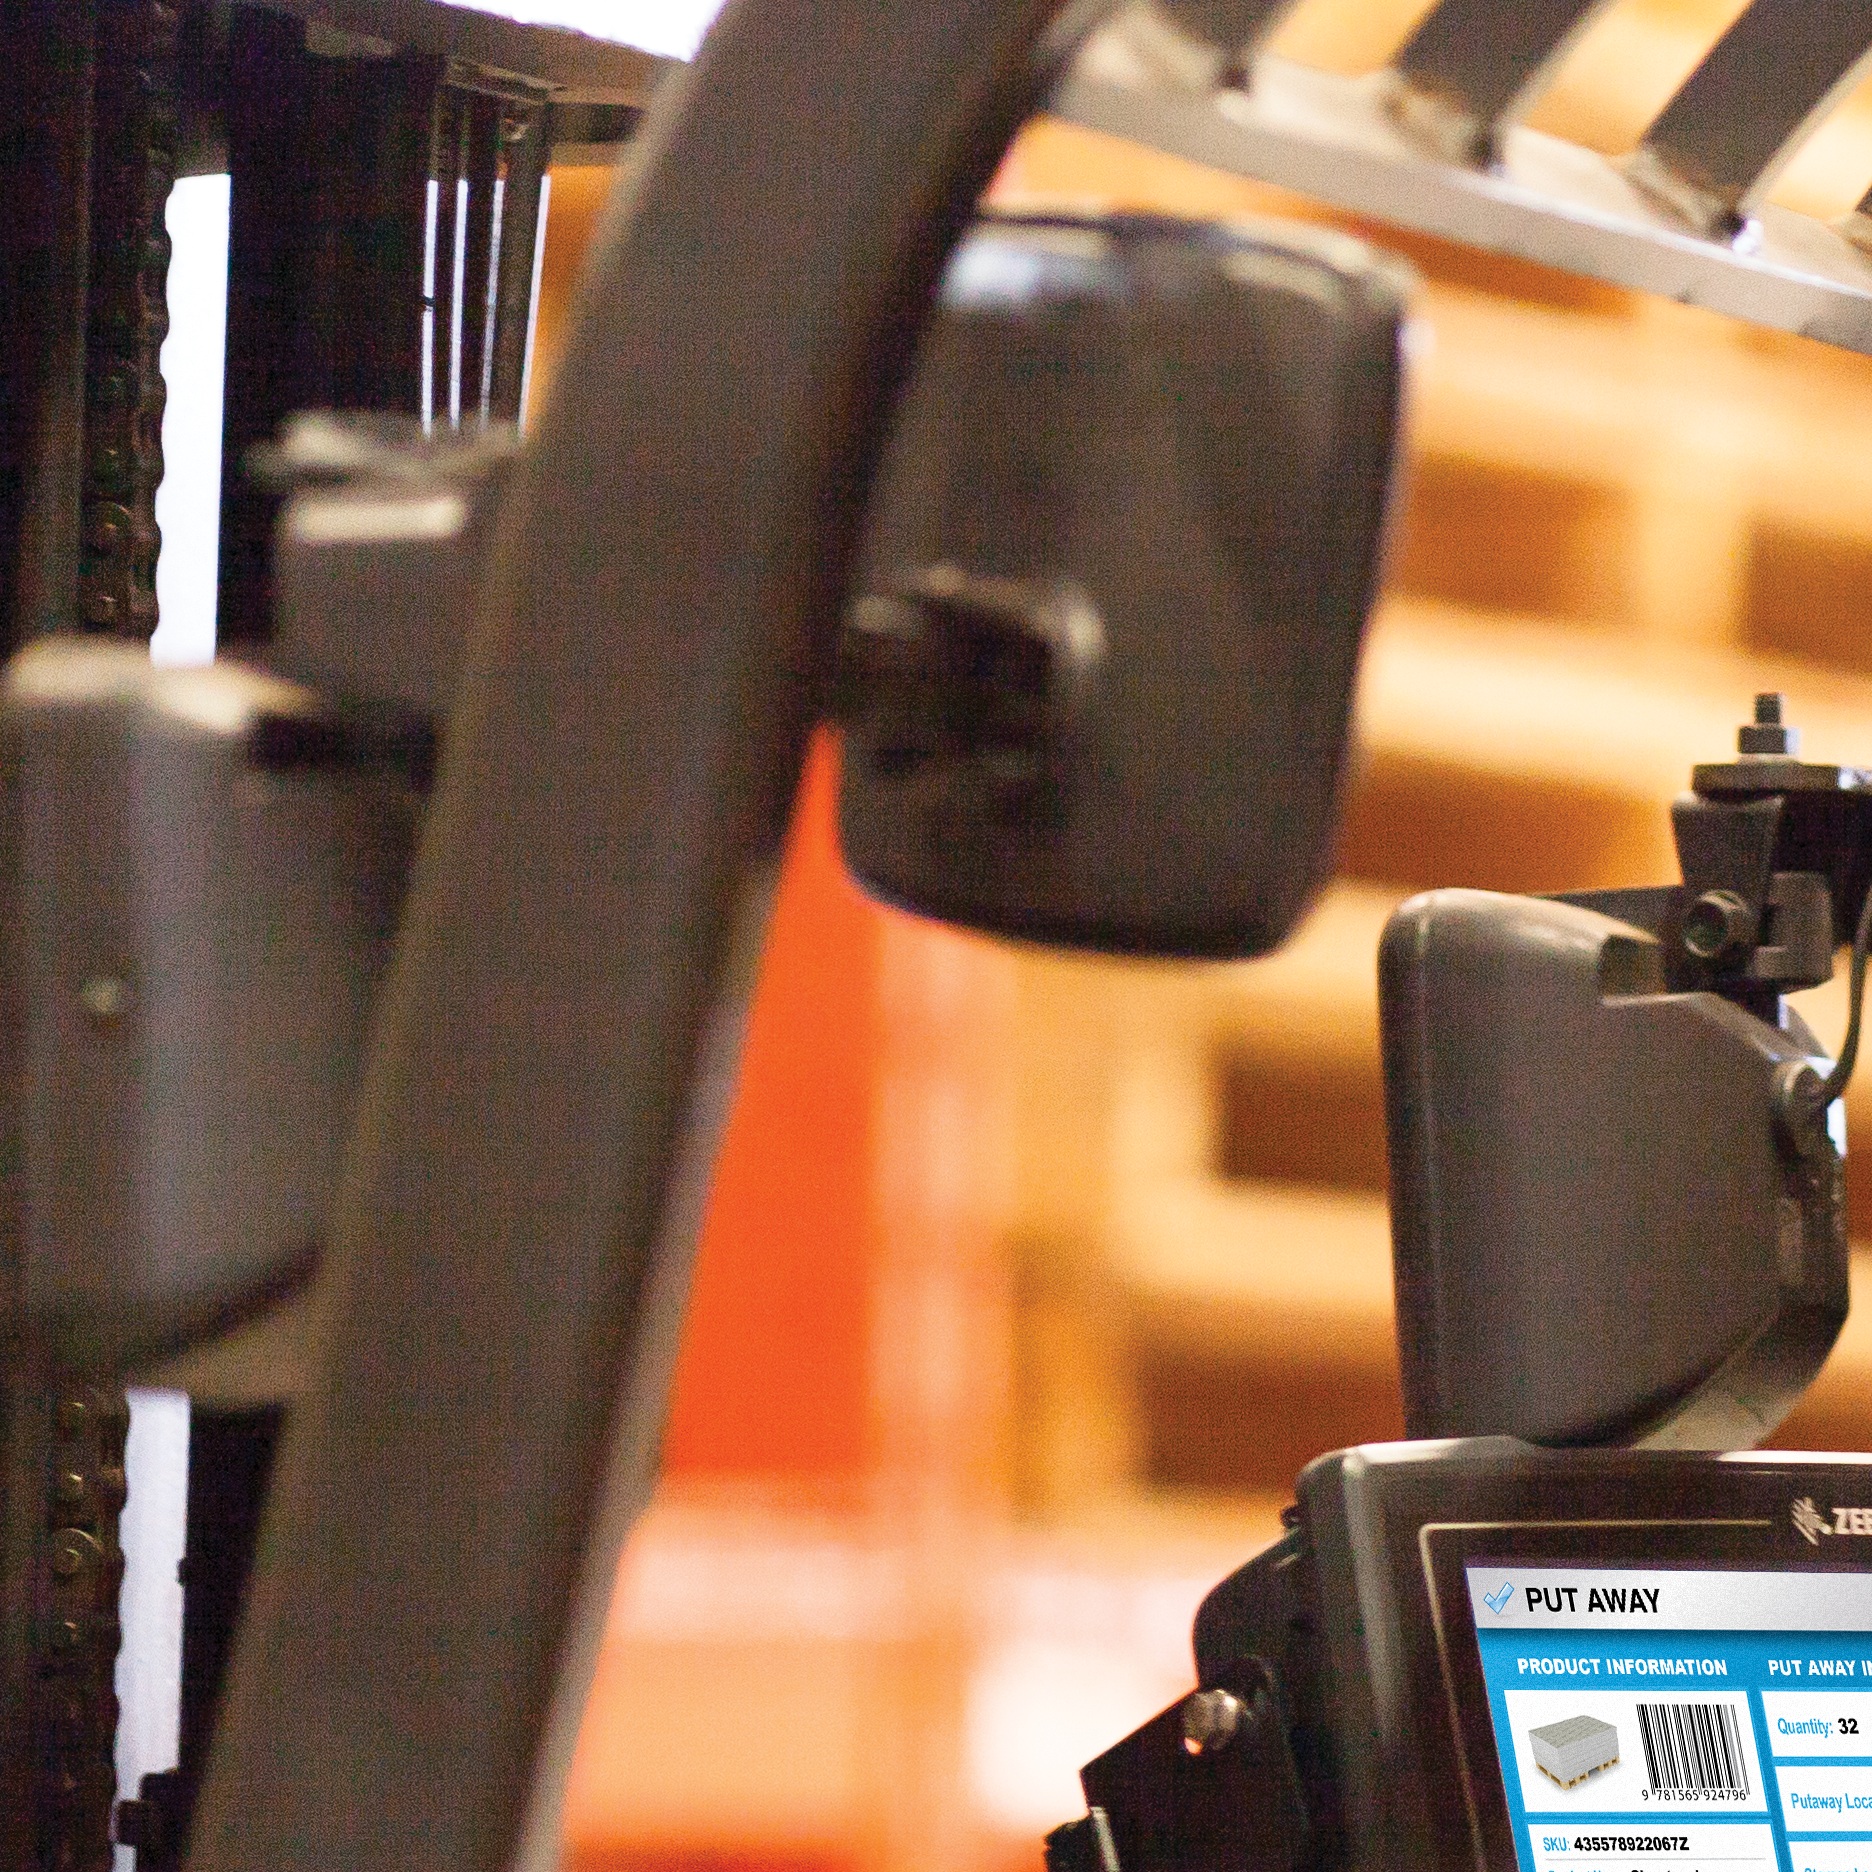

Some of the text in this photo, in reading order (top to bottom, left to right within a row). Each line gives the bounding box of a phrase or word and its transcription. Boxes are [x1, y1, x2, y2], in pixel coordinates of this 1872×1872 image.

[1525, 1587, 1660, 1614] PUT AWAY
[1517, 1658, 1728, 1676] PRODUCT INFORMATION
[1768, 1659, 1801, 1676] PUT
[1808, 1660, 1855, 1676] AWAY
[1777, 1718, 1859, 1738] Quantity: 32
[1642, 1789, 1747, 1801] 9 781565 924796
[1791, 1793, 1843, 1813] Putaway
[1543, 1836, 1690, 1851] SKU: 435578922067Z
